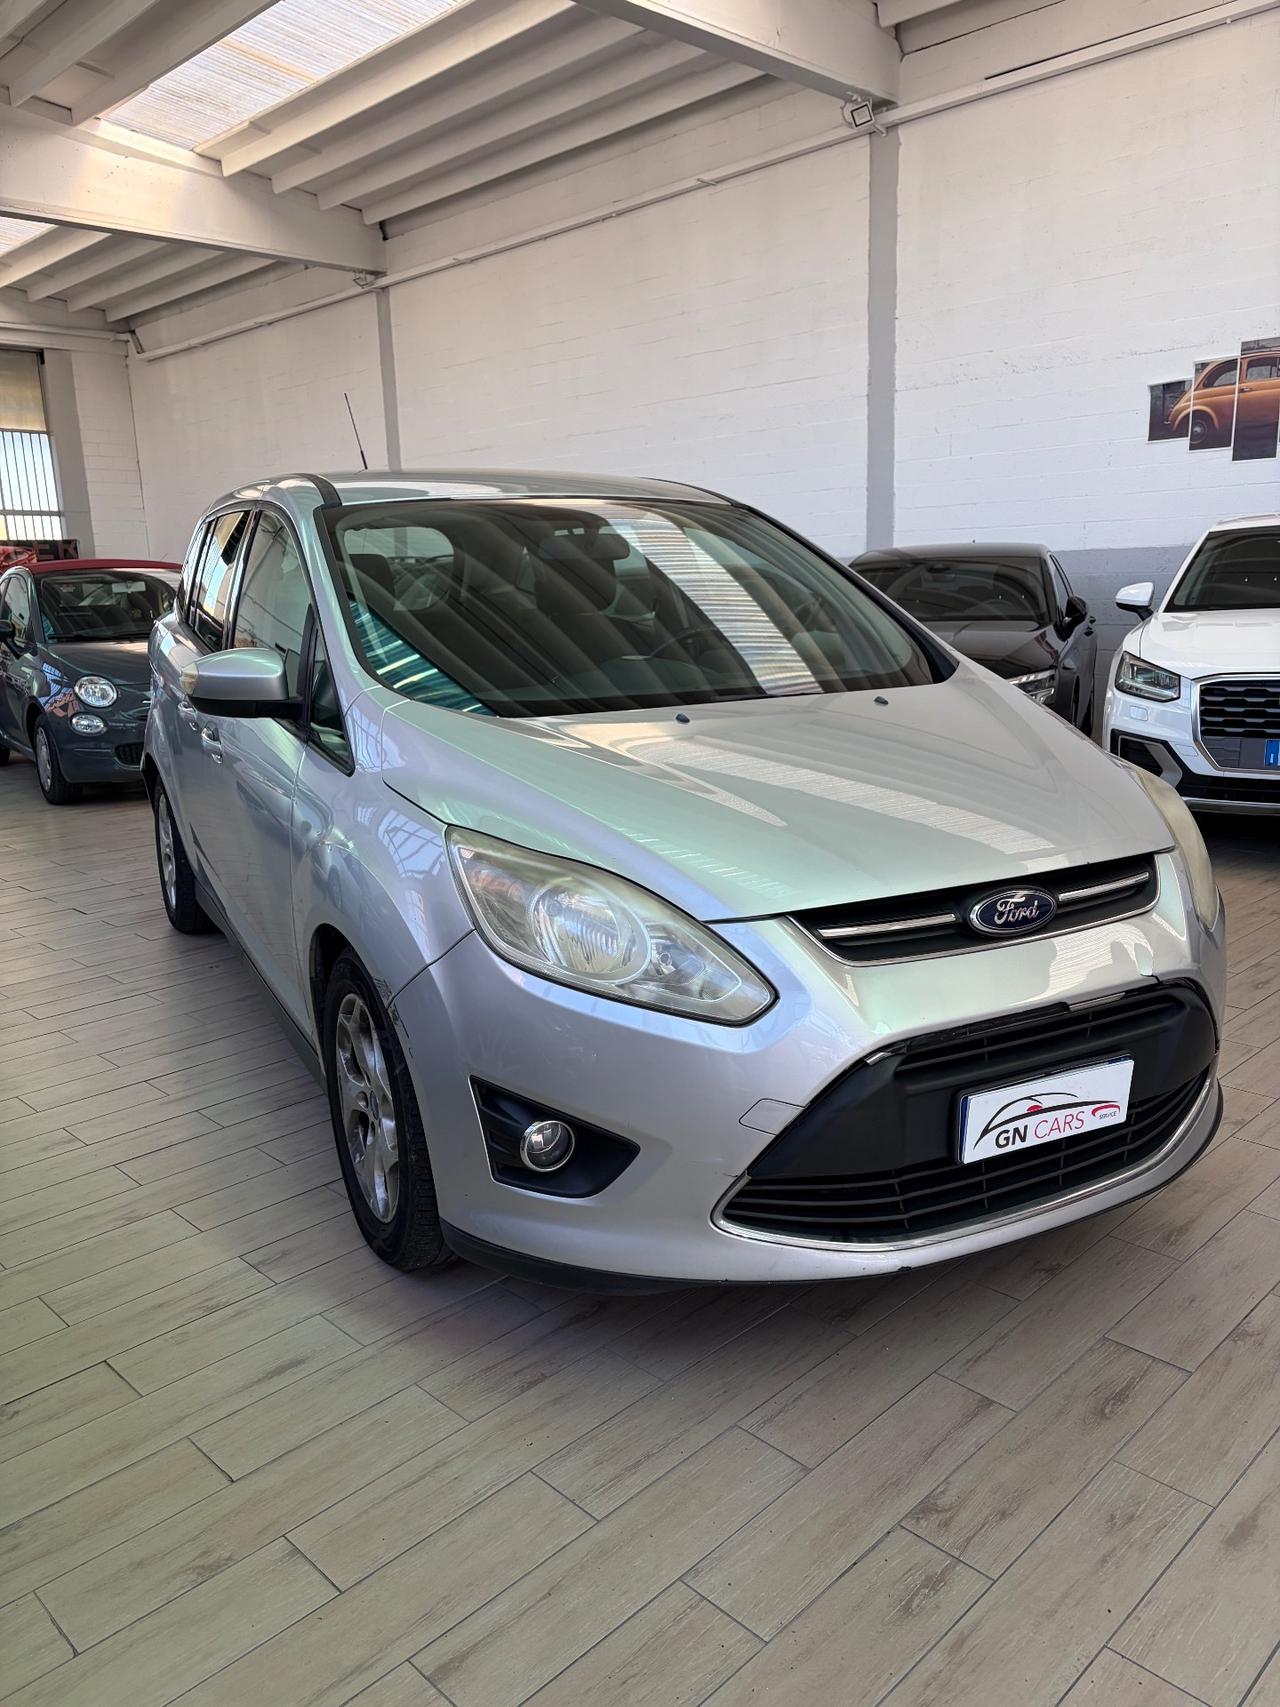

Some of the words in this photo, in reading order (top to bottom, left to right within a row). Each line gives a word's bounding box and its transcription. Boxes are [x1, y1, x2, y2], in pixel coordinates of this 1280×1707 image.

[994, 893, 1040, 925] Ford
[995, 1125, 1028, 1149] GN
[1034, 1111, 1085, 1139] CARS
